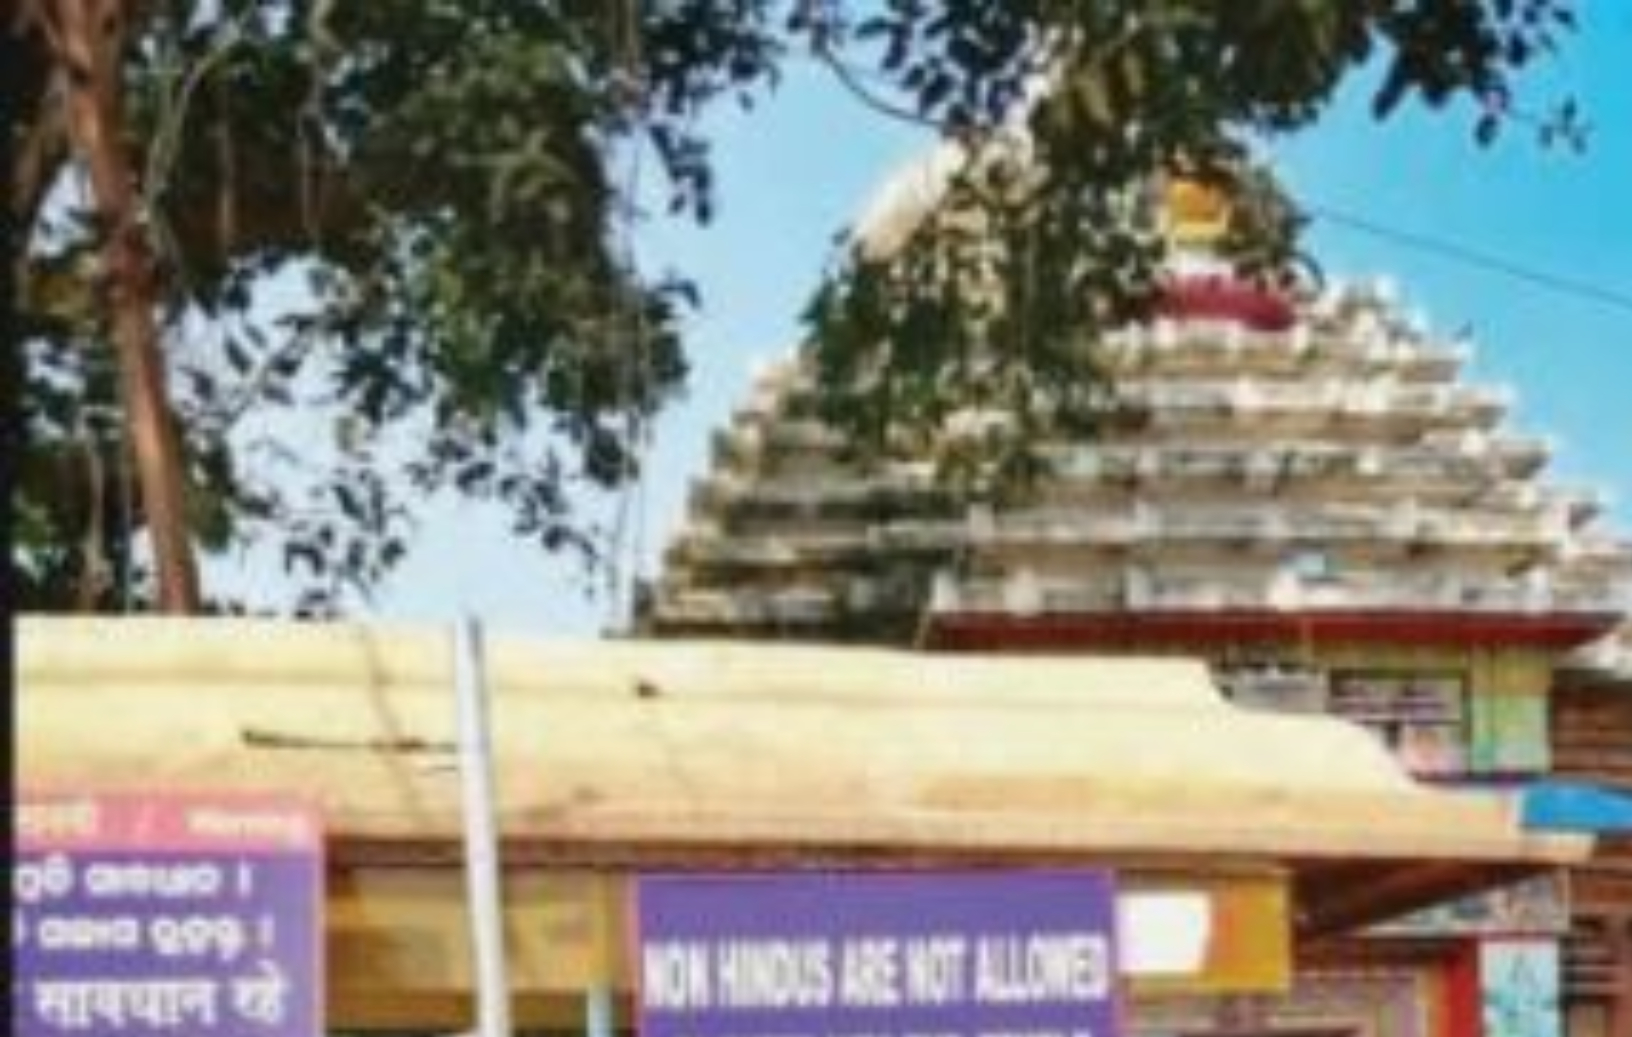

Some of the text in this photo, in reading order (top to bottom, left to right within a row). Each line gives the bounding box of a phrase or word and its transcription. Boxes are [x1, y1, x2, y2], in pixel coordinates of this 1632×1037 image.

[643, 932, 1109, 1008] NON HINDUS ARE NOT ALLOWED
[35, 980, 217, 1026] सावधान
